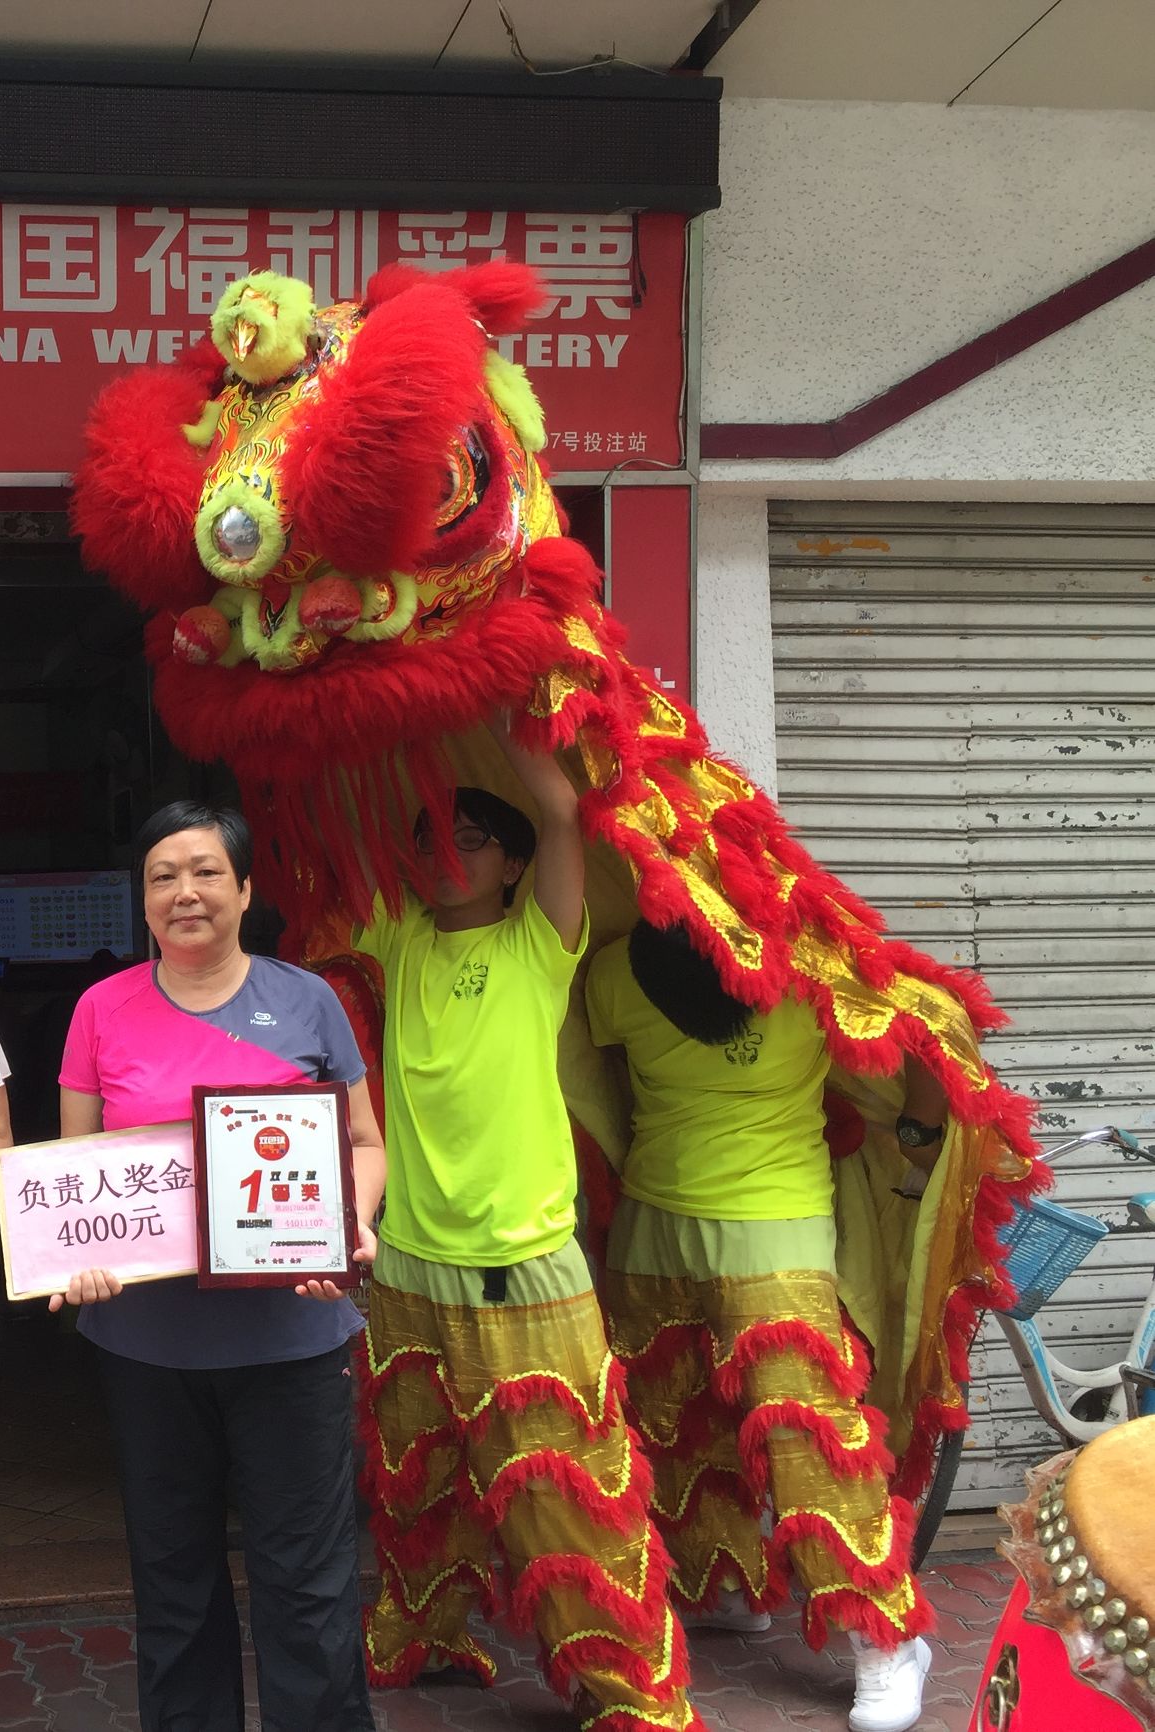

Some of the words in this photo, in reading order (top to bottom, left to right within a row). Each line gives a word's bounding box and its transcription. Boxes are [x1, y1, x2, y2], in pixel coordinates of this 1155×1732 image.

[543, 432, 647, 453] 7号投注站
[18, 1158, 195, 1215] 负责人奖金
[240, 1169, 263, 1214] 1
[55, 1206, 165, 1248] 4000元
[285, 1219, 324, 1227] 44011107
